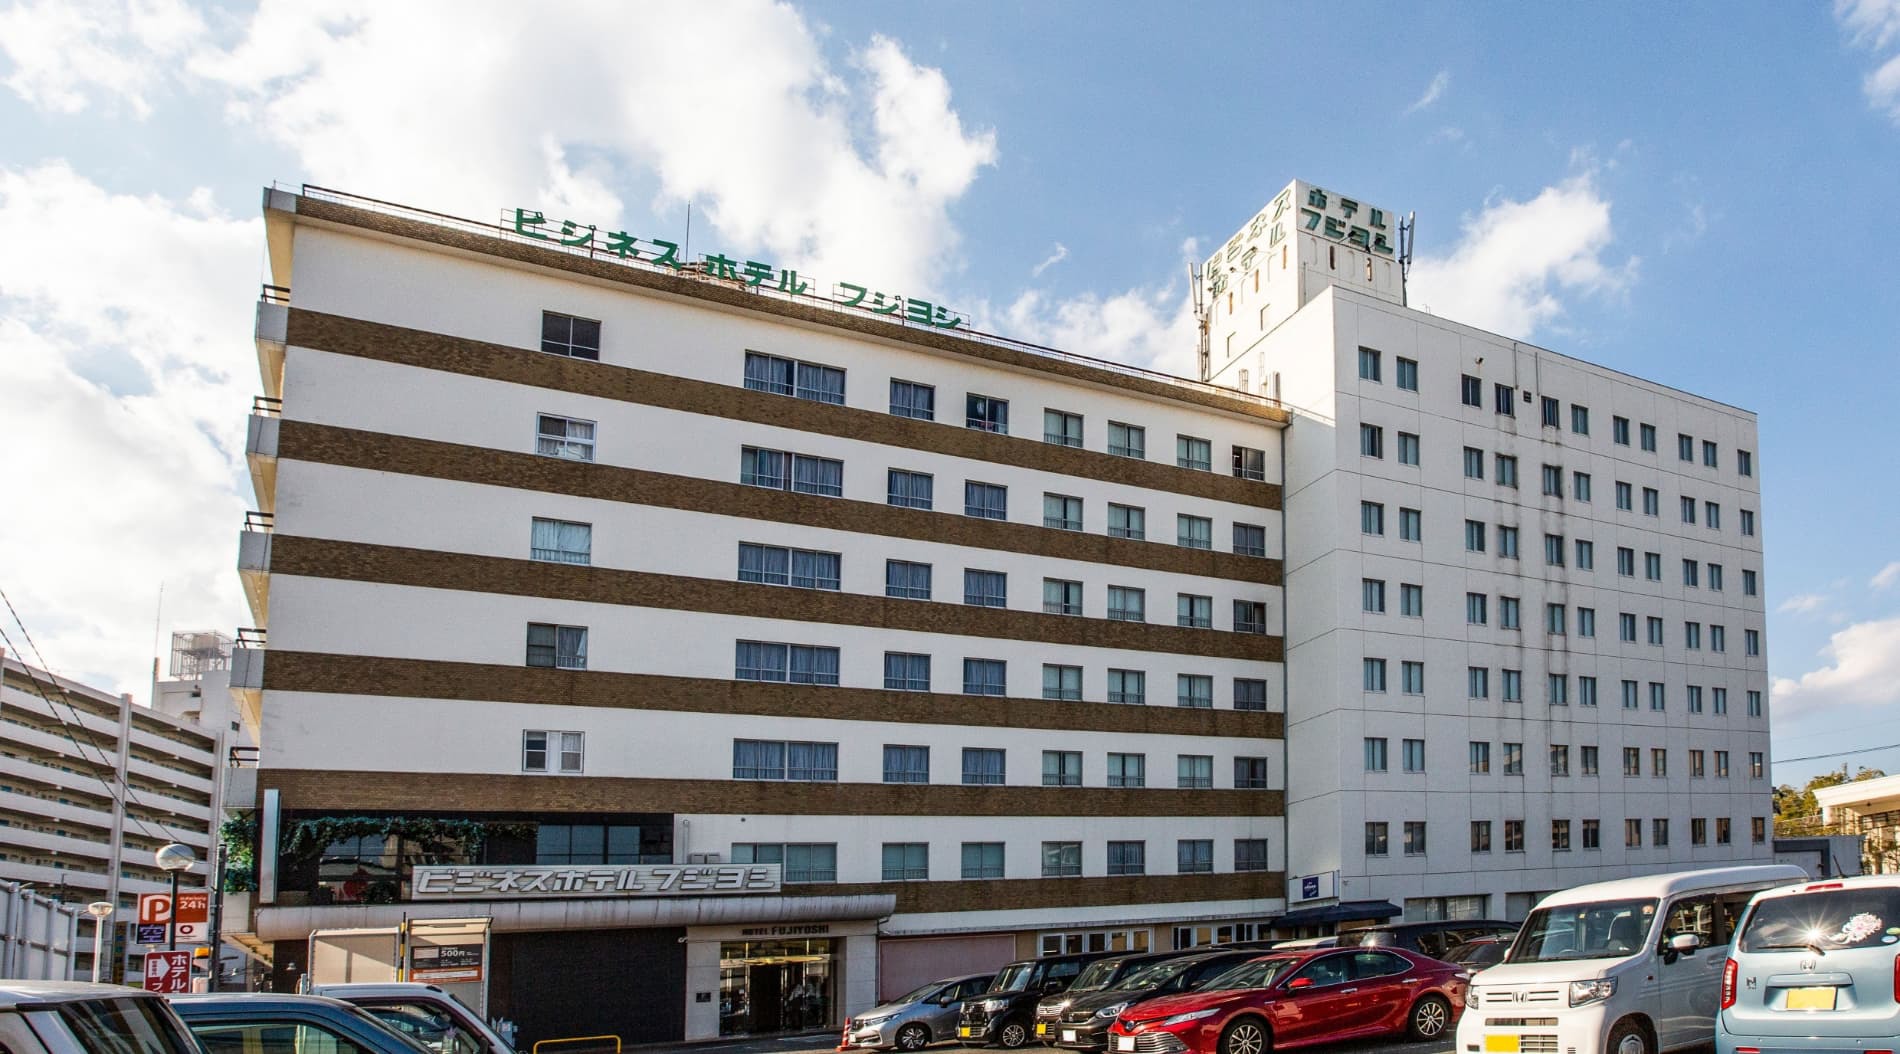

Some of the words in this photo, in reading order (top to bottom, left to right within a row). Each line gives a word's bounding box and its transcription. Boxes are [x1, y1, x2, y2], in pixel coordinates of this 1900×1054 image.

[1308, 188, 1387, 231] ホテル
[1300, 207, 1394, 255] フジヨシ
[515, 207, 682, 270] ビジネス
[705, 253, 808, 296] ホテル
[839, 281, 962, 329] フジヨシ
[142, 894, 173, 922] P
[179, 901, 206, 910] 24h
[742, 927, 769, 936] HOTEL
[771, 924, 830, 935] FUJIYOSHI
